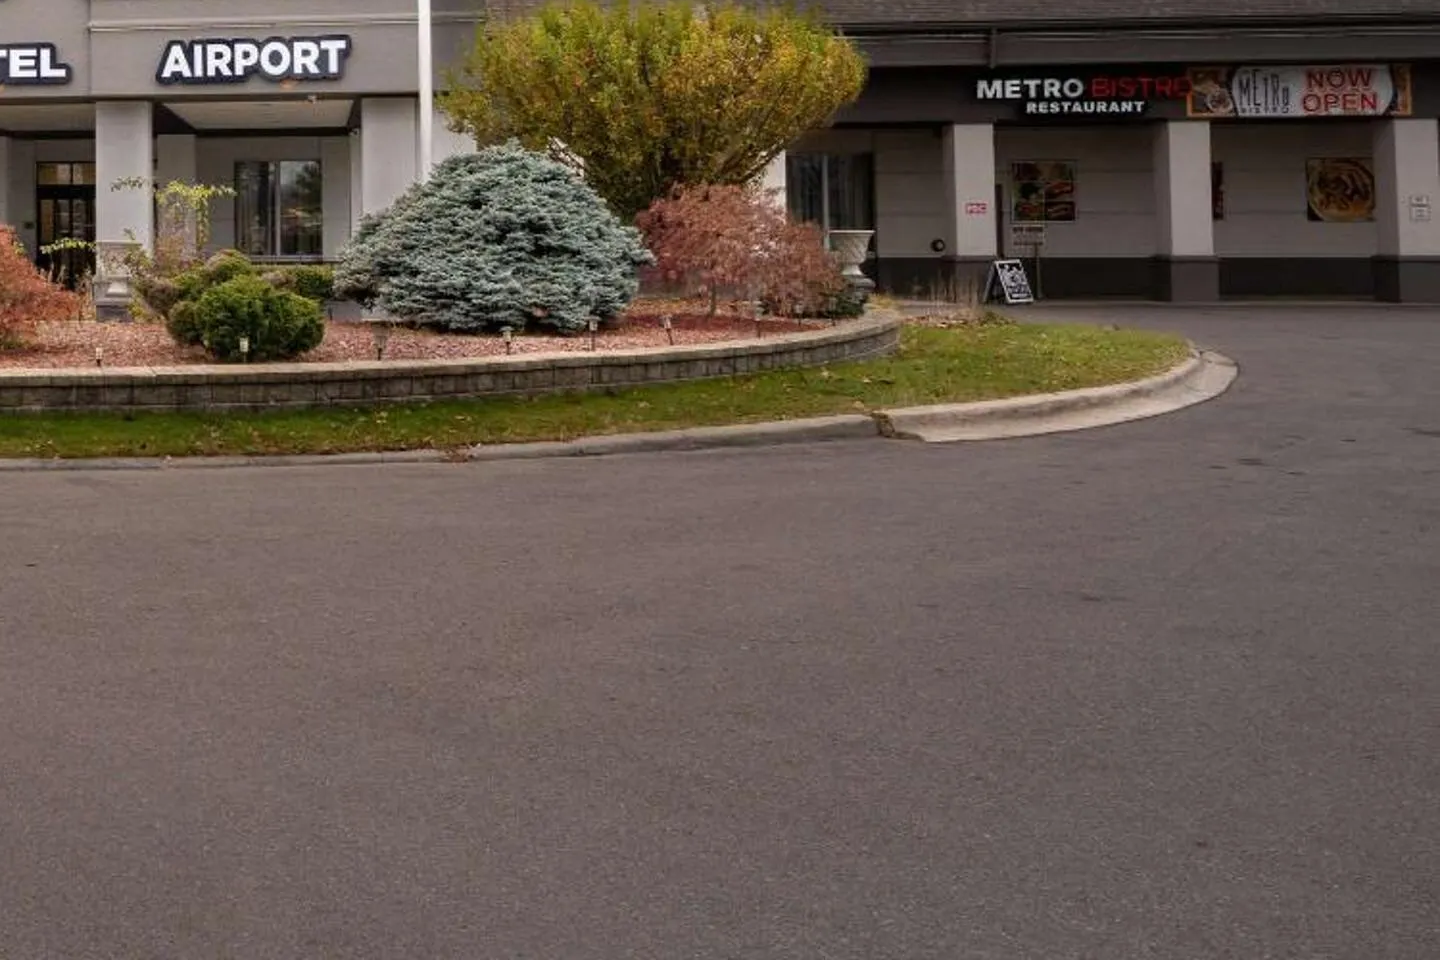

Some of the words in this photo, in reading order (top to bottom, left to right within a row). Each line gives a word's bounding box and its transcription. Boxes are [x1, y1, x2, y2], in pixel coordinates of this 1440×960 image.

[161, 40, 347, 78] AIRPORT
[976, 78, 1084, 99] METRO
[1091, 75, 1193, 98] BISTRO
[1304, 67, 1373, 88] NOW
[1026, 100, 1146, 114] RESTAURANT
[1302, 92, 1378, 112] OPEN
